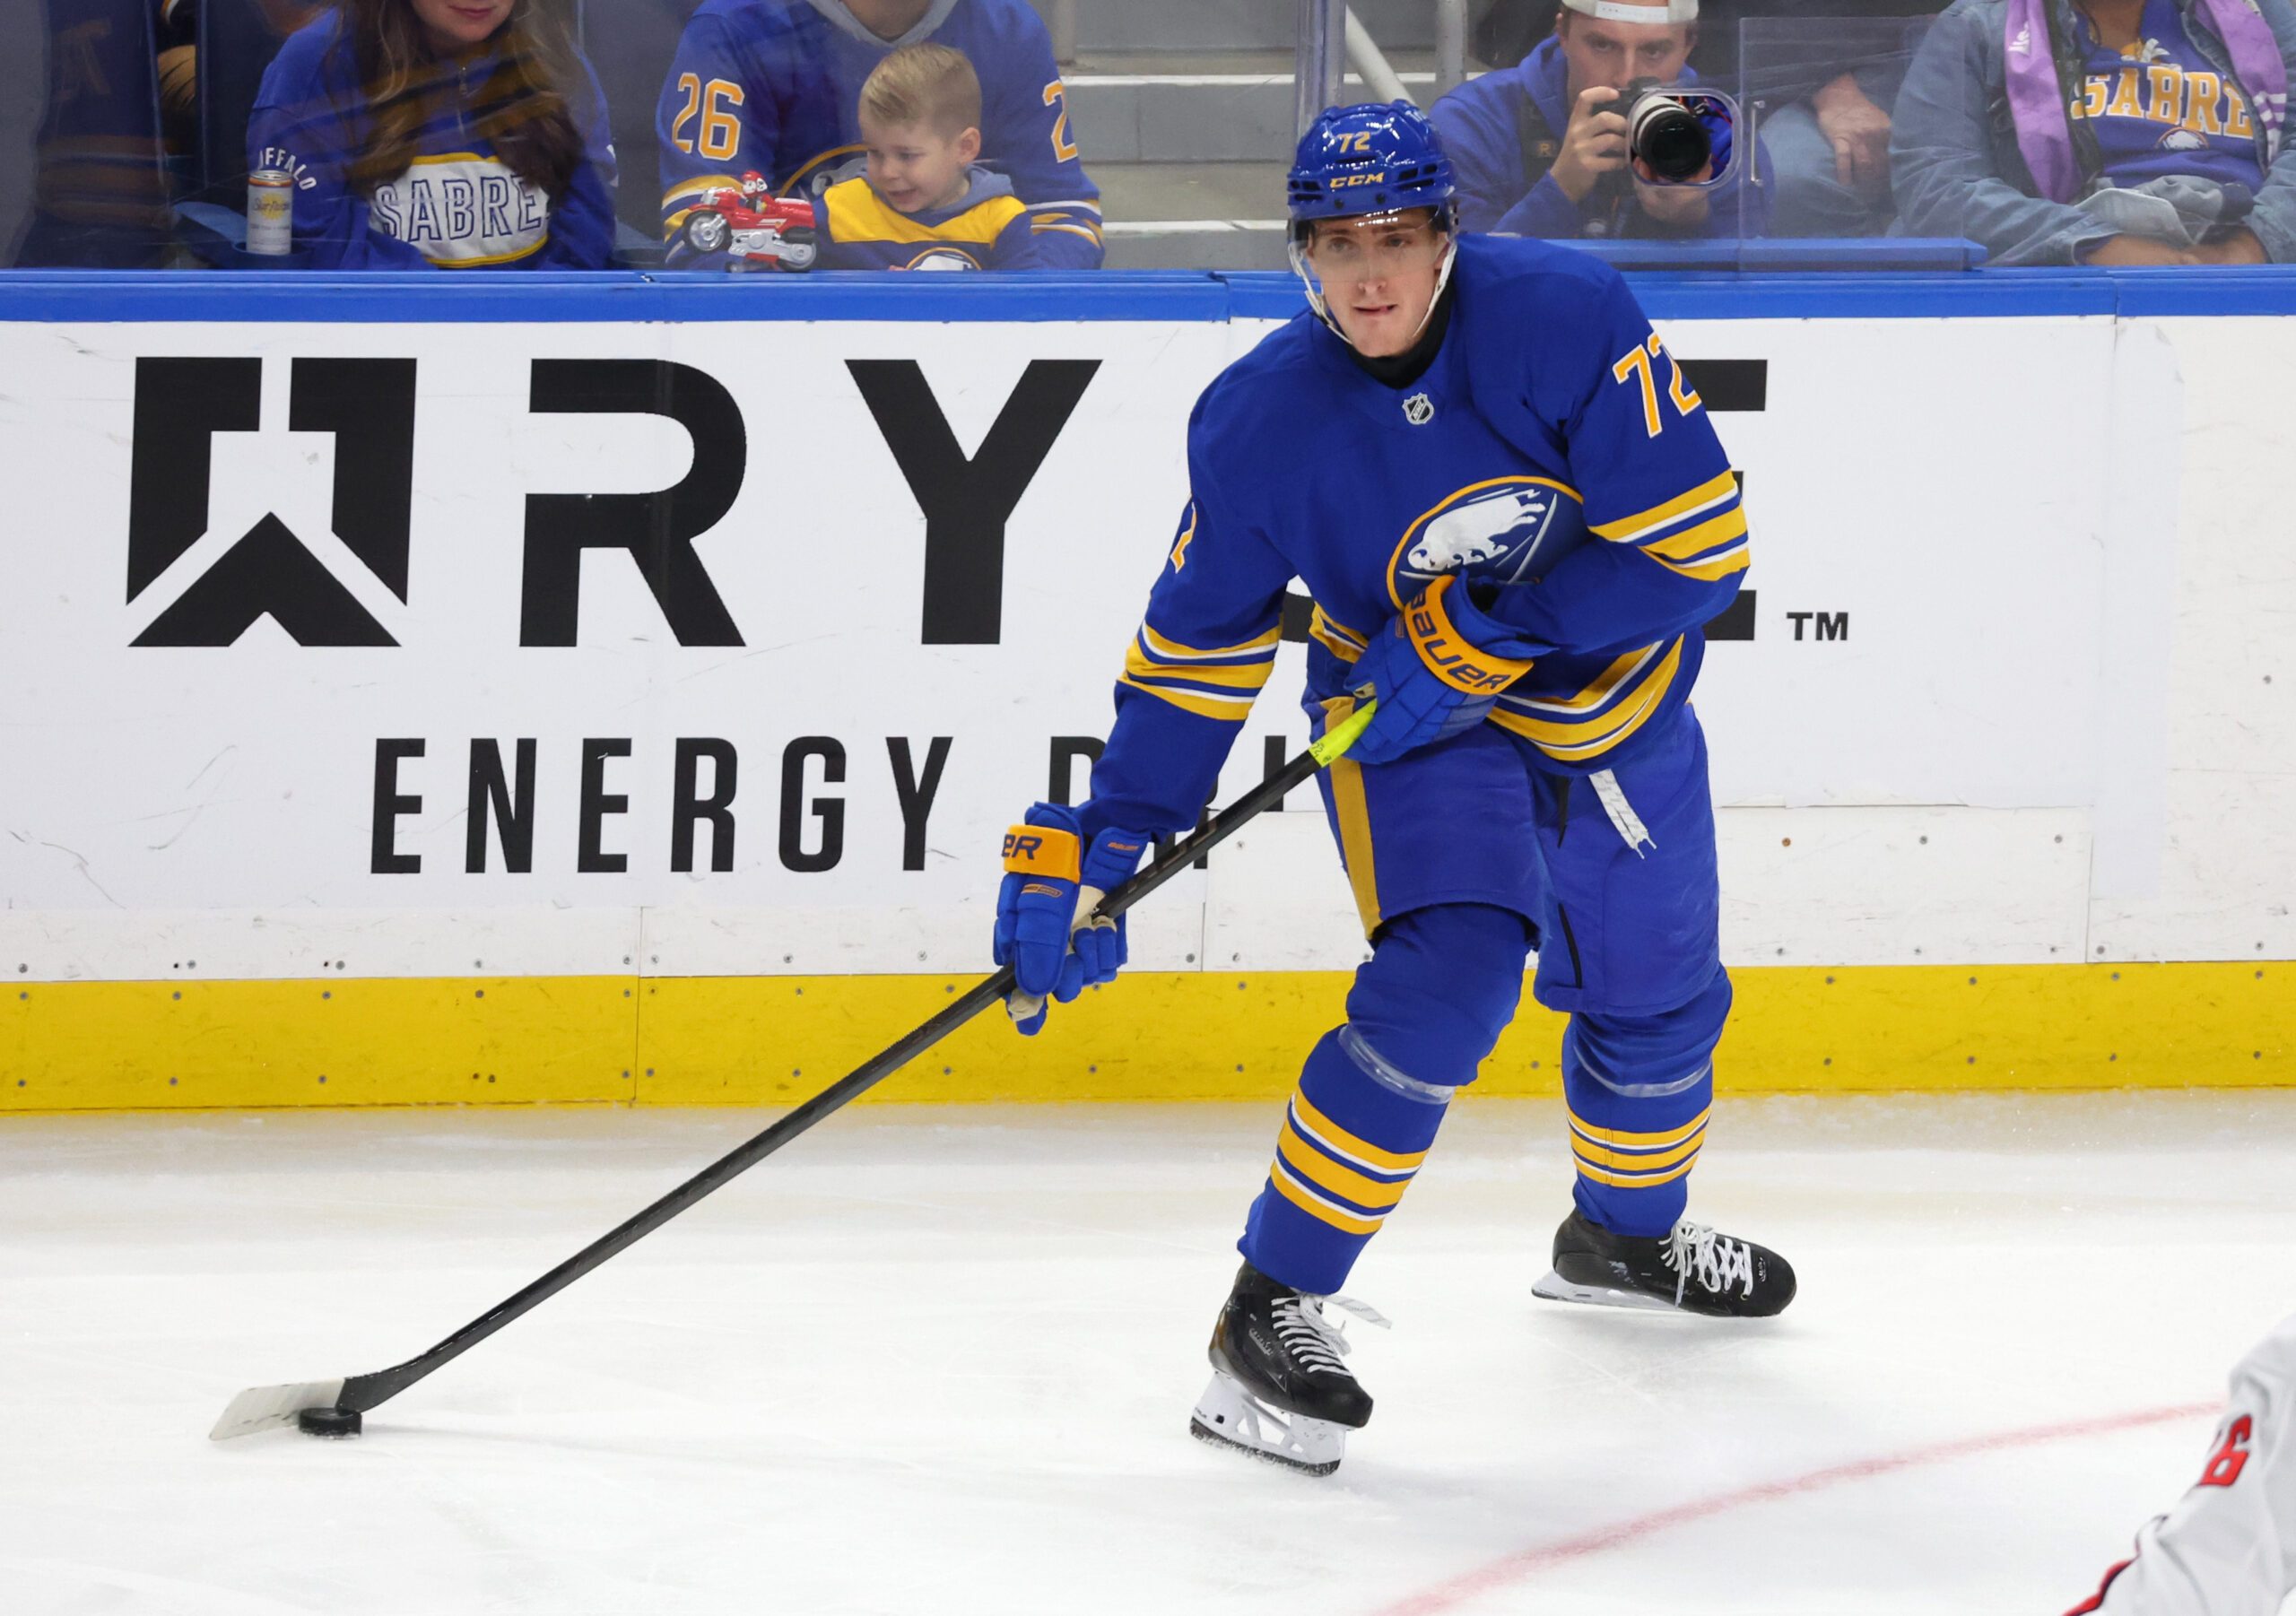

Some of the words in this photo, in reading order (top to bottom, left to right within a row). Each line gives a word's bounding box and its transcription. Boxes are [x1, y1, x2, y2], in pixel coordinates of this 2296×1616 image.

[672, 72, 745, 161] 26
[2070, 65, 2254, 140] SABRE
[1336, 131, 1371, 154] 72
[375, 175, 550, 242] SABRE
[1329, 172, 1385, 188] CCM
[1613, 331, 1702, 439] 72
[1787, 612, 1848, 641] TM
[370, 735, 953, 873] ENERGY
